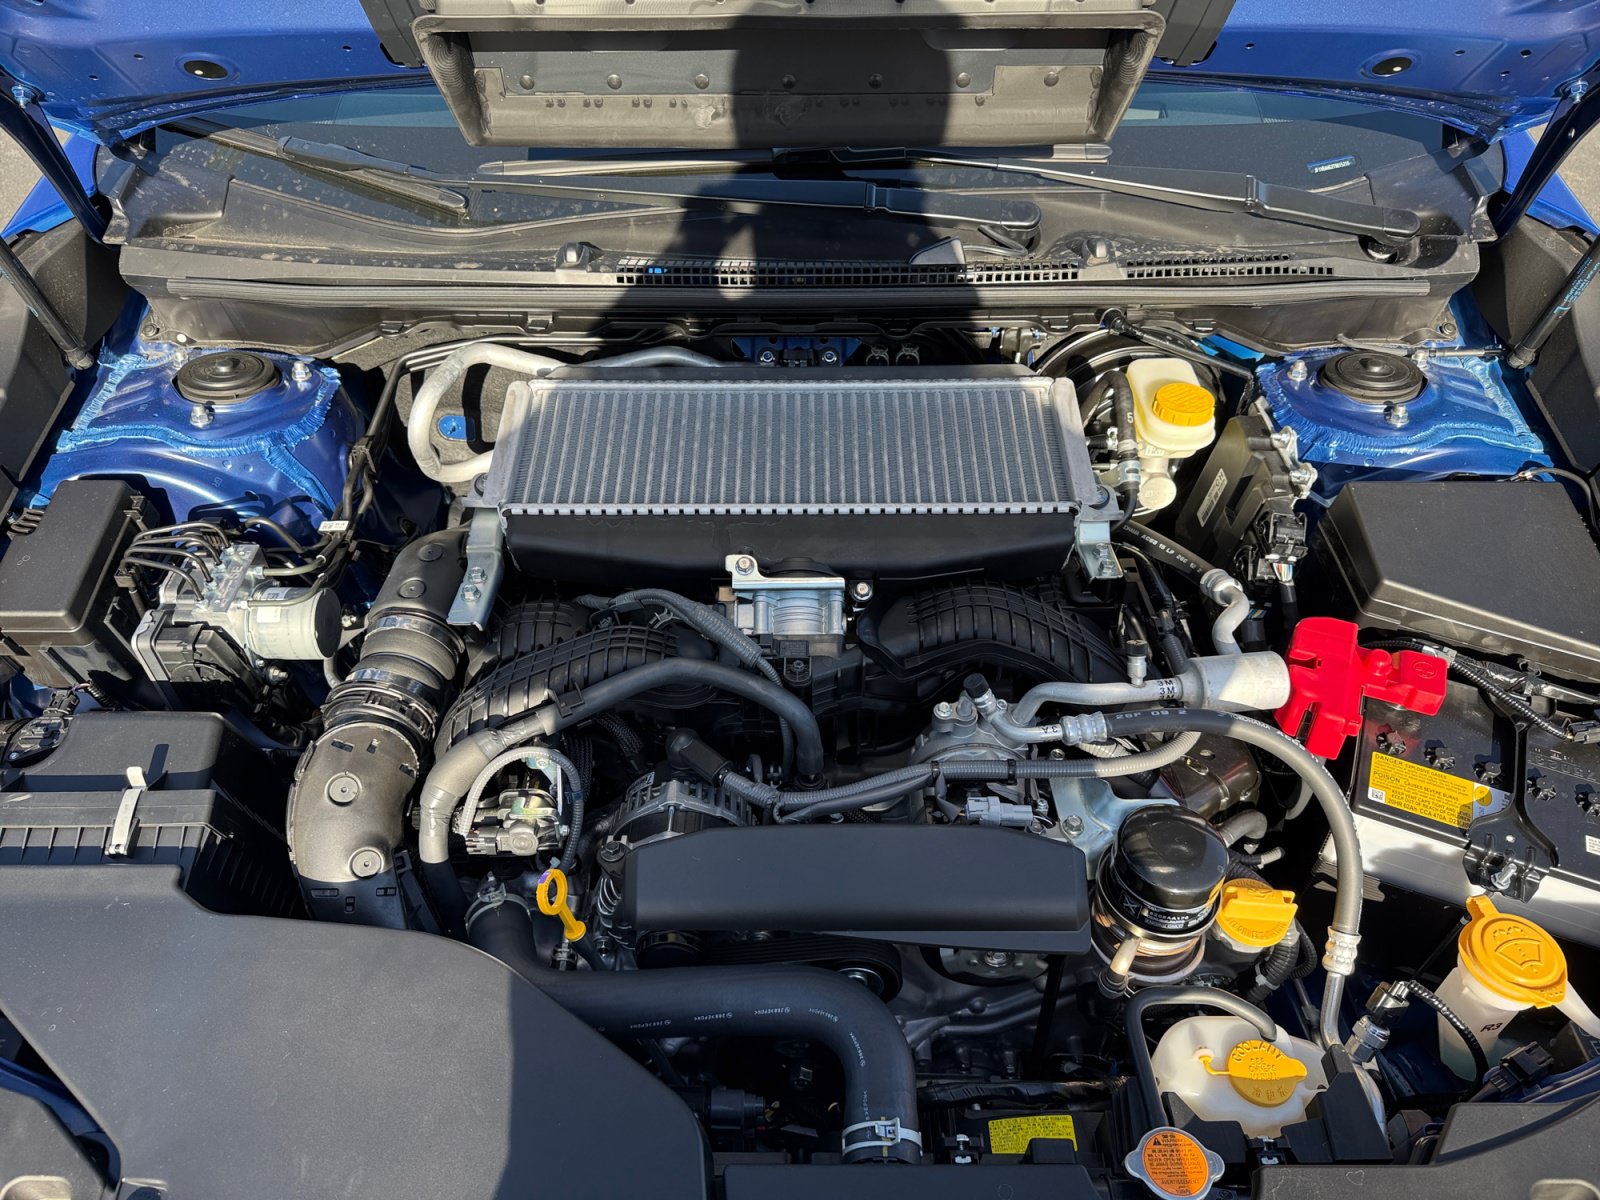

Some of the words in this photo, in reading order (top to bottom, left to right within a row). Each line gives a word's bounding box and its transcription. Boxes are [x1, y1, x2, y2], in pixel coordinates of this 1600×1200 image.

[1127, 412, 1134, 424] 5
[1375, 753, 1403, 766] DANGER
[1373, 771, 1401, 783] POISON
[1480, 1022, 1502, 1032] R3
[1232, 1040, 1284, 1062] COOLANT
